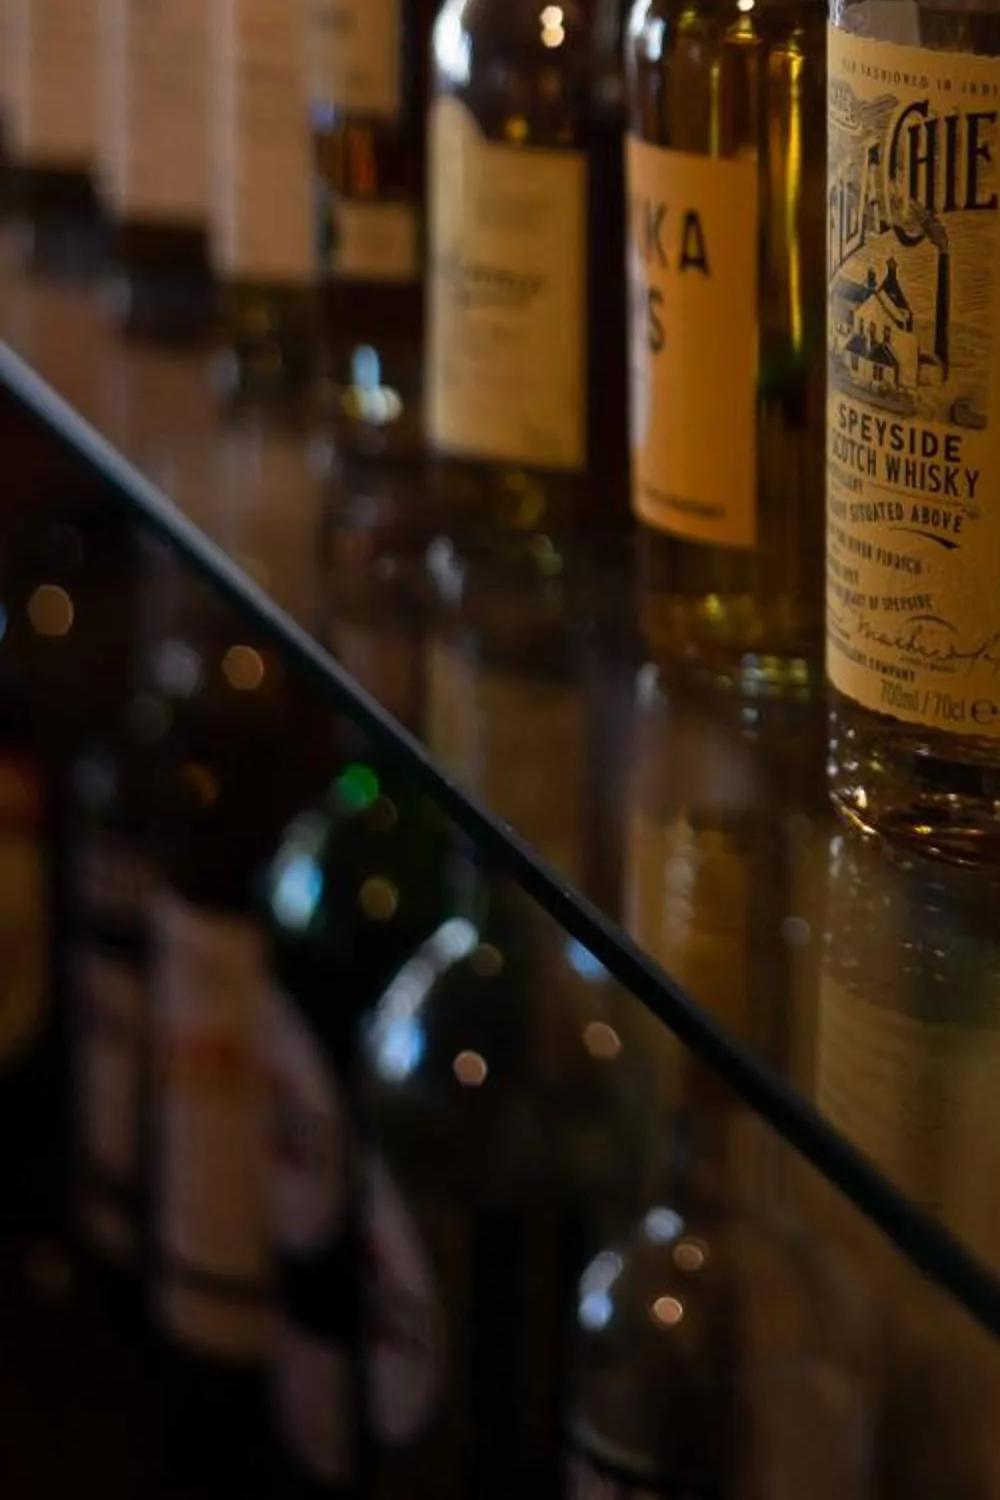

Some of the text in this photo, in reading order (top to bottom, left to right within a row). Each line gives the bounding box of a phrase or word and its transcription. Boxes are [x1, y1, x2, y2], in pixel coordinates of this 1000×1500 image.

[861, 62, 930, 90] FASHIONED
[936, 78, 952, 93] IN
[838, 403, 963, 463] SPEYSIDE
[885, 452, 980, 499] WHISKY
[910, 504, 963, 534] ABOVE
